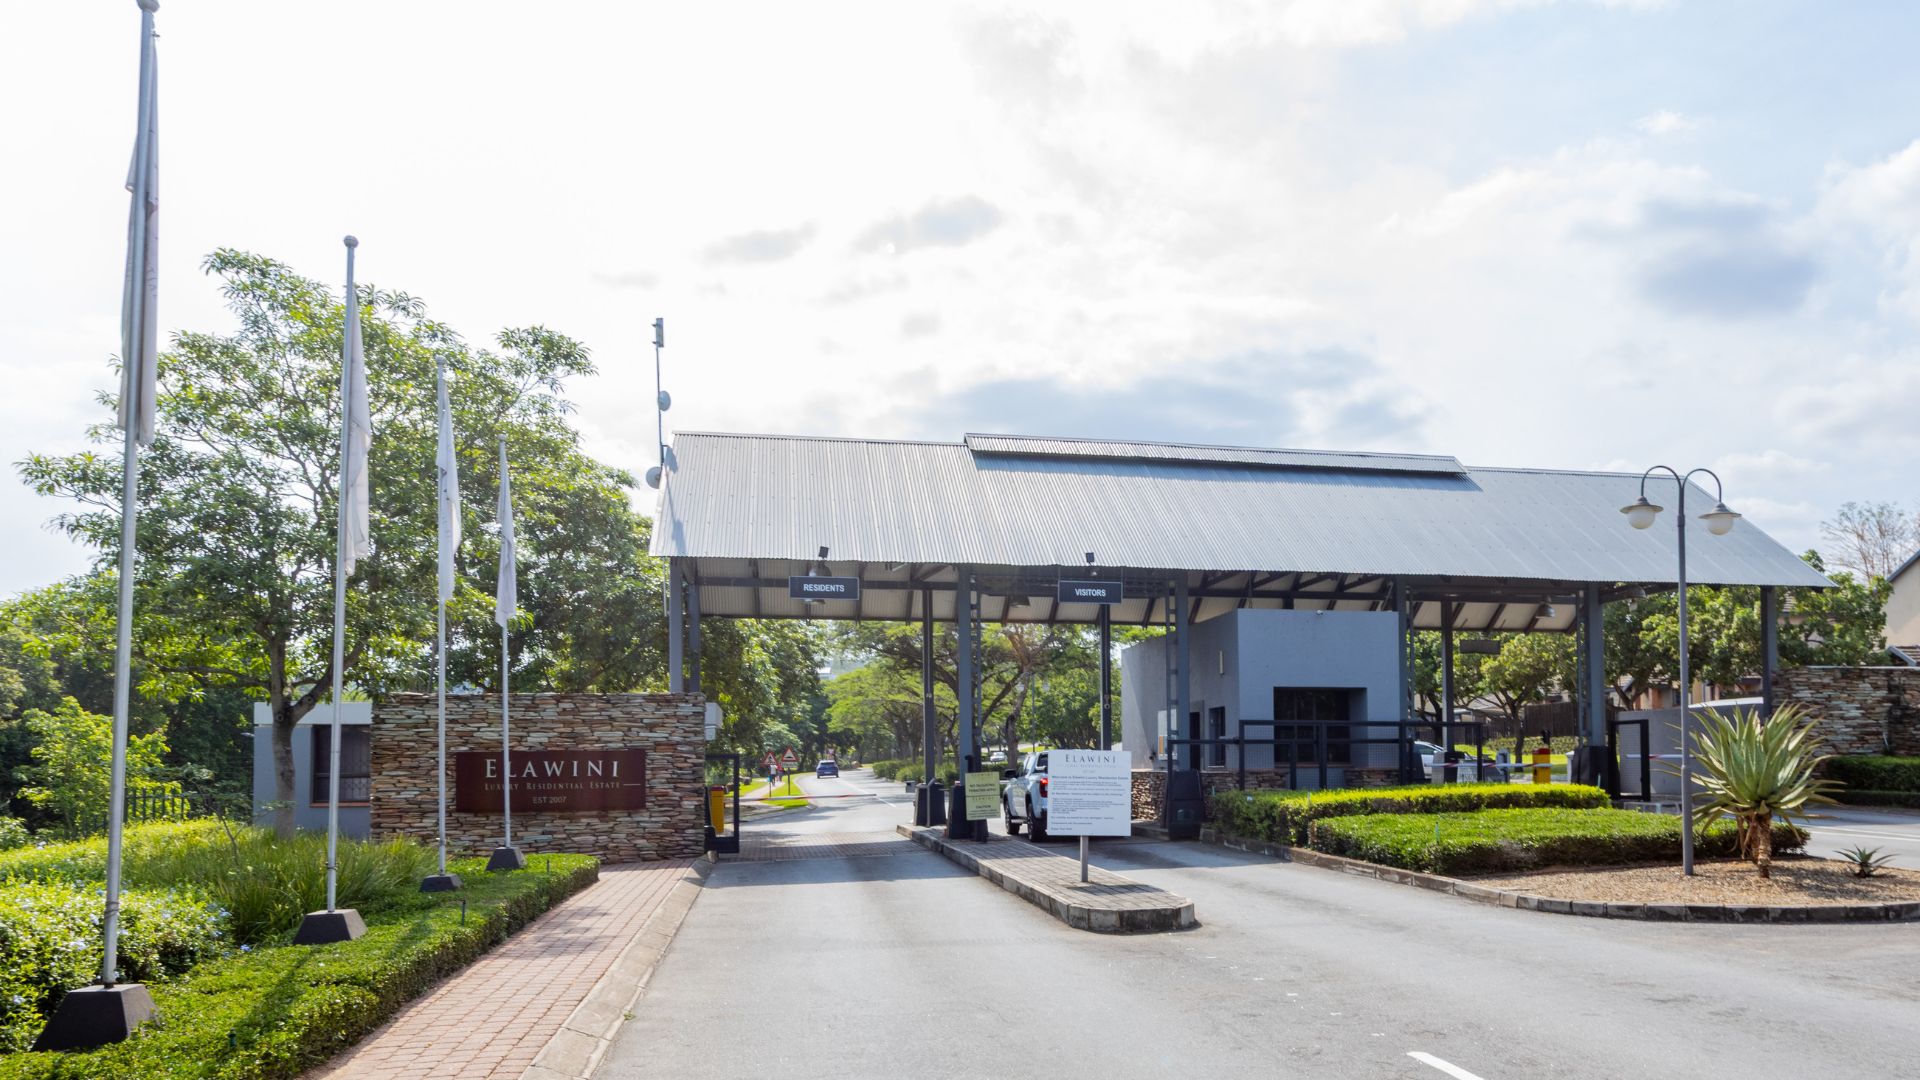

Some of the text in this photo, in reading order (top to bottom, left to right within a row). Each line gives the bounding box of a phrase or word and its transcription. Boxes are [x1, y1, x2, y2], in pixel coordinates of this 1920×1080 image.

[803, 583, 845, 592] RESIDENTS
[1074, 588, 1106, 597] VISITORS
[1065, 754, 1116, 763] ELAWINI
[485, 758, 619, 778] ELAWINI
[485, 781, 620, 791] LUXRY RESIDENTIAL ESTATE
